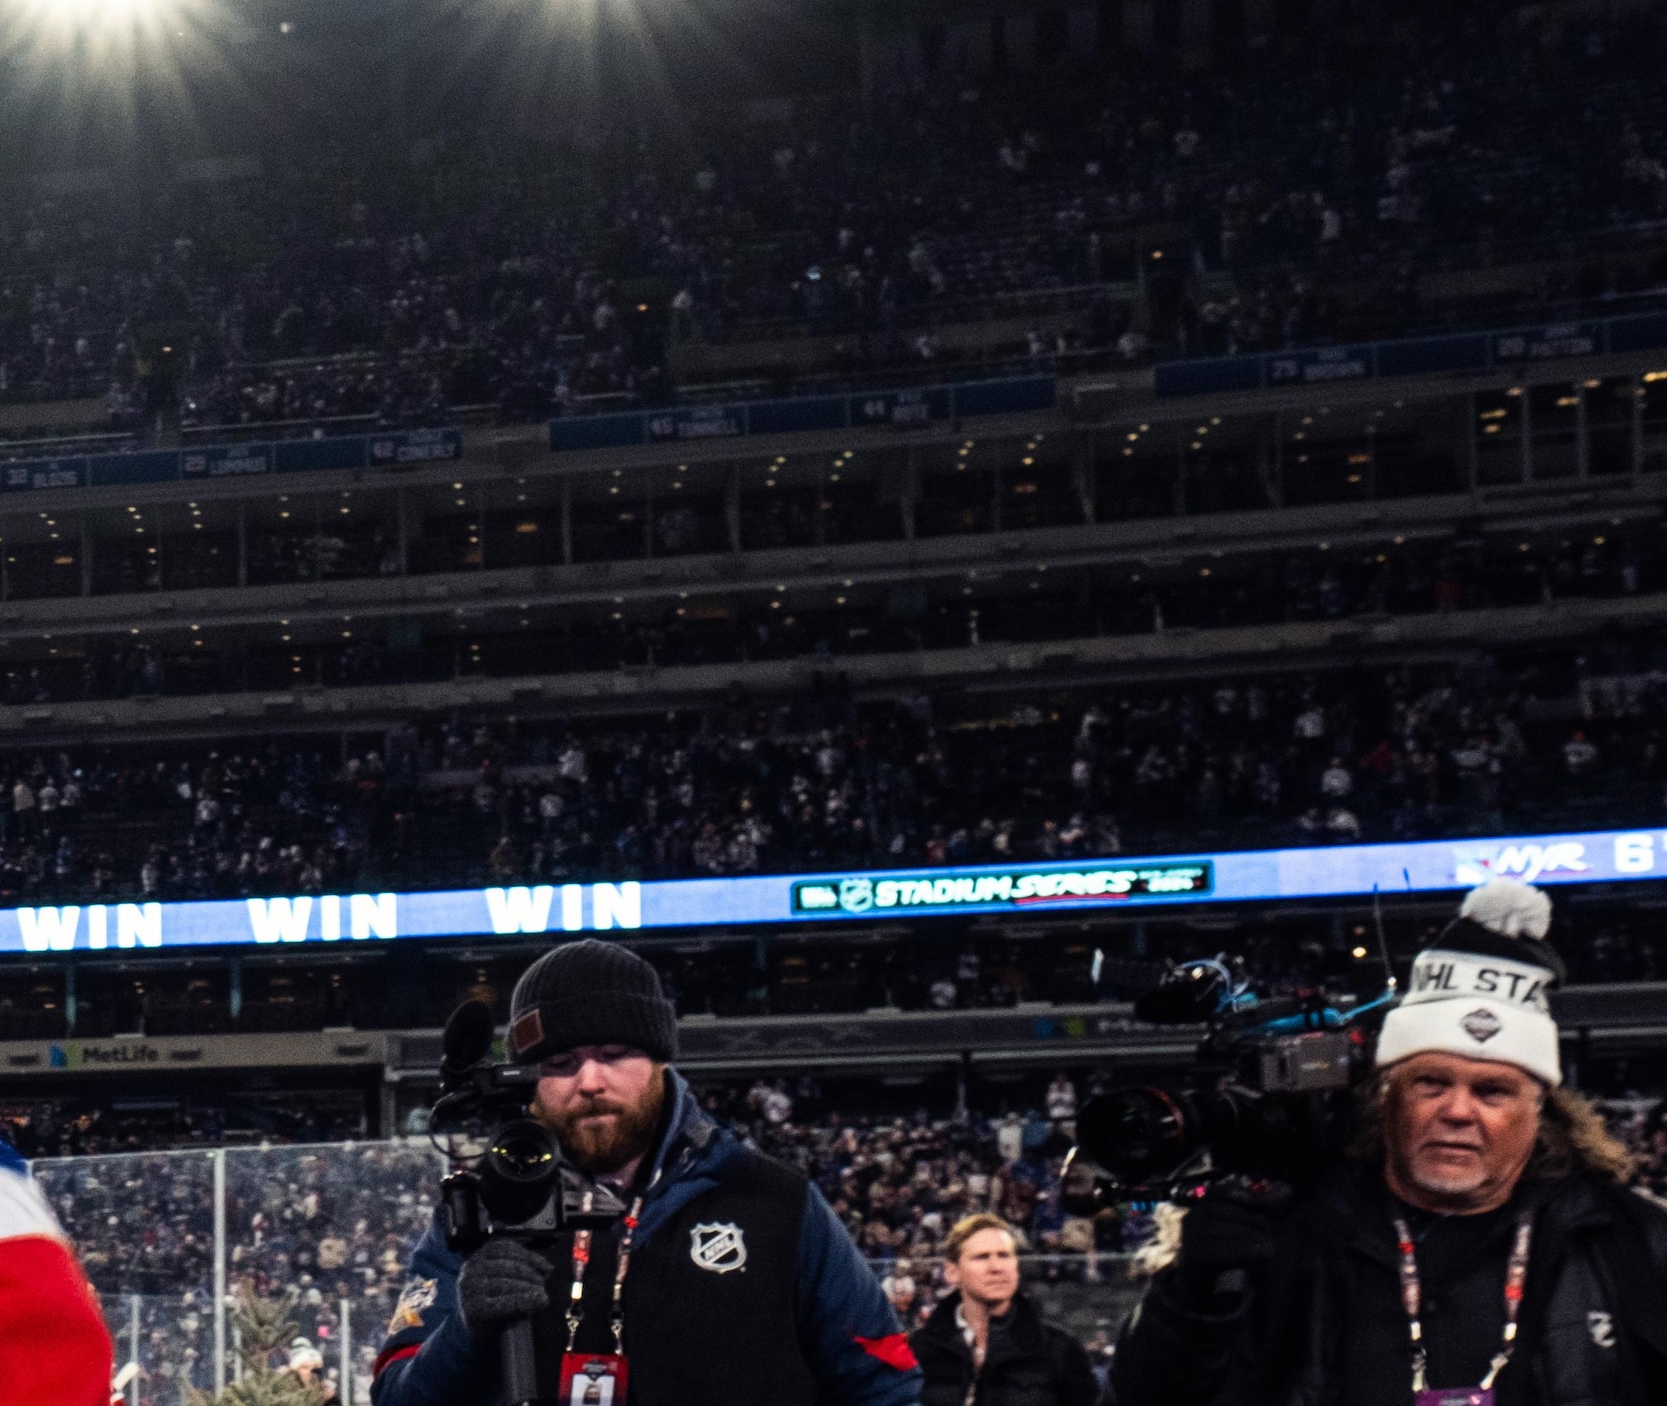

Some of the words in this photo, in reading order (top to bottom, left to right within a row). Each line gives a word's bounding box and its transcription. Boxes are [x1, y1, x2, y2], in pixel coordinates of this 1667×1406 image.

[16, 902, 162, 951] WIN
[247, 892, 397, 943] WIN
[485, 881, 642, 933] WIN
[875, 875, 1012, 907] STADIUM
